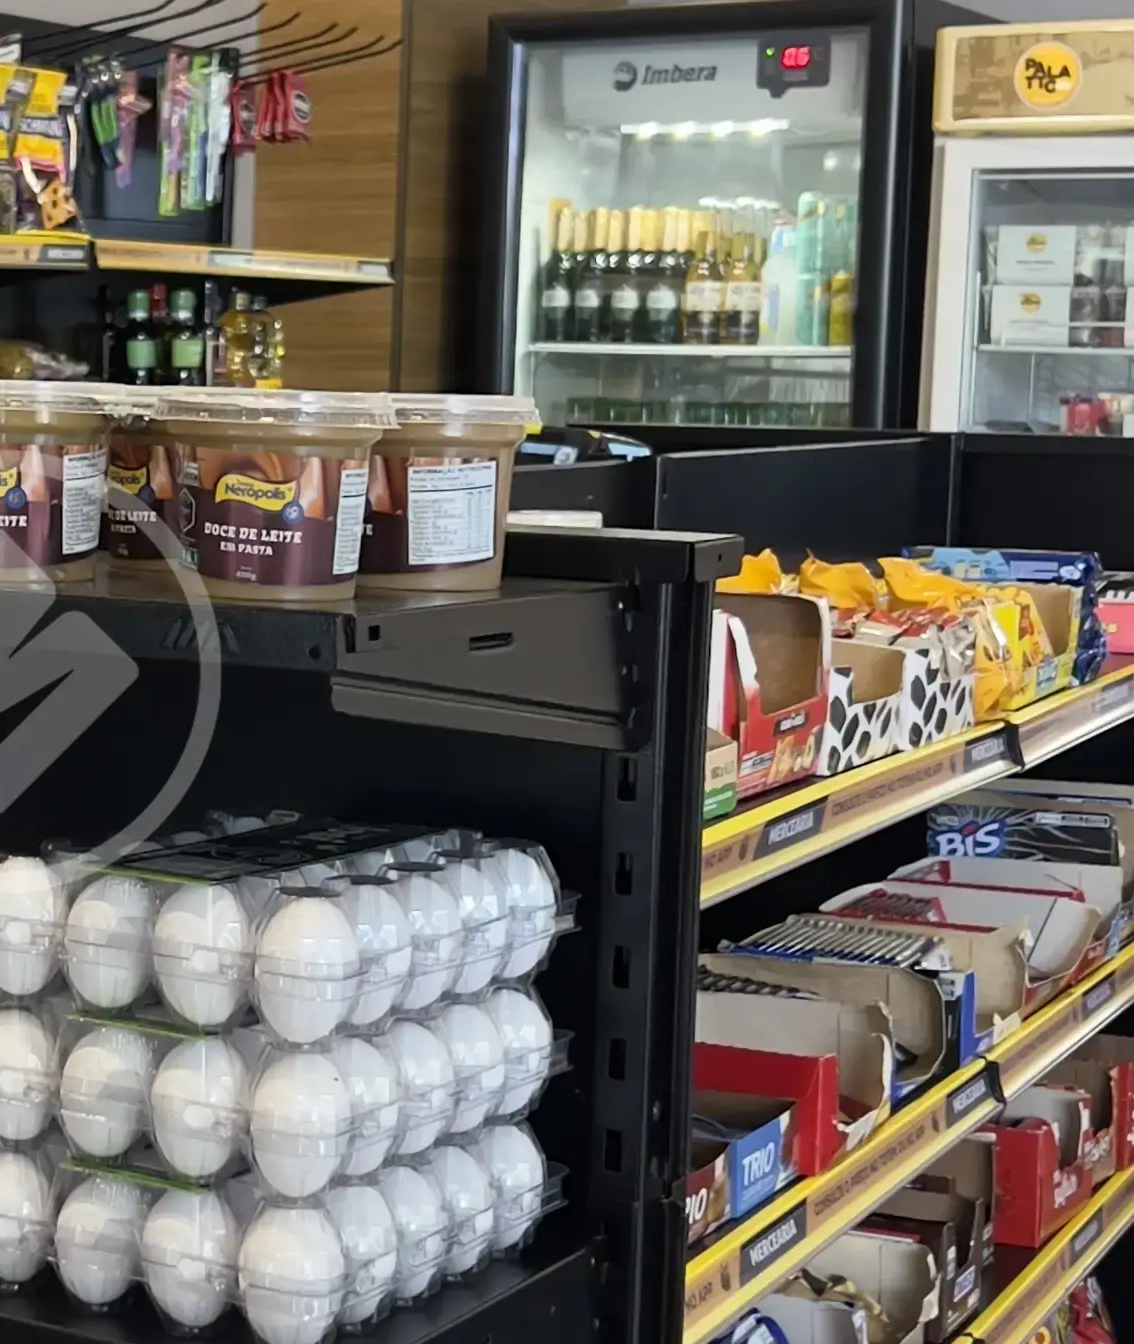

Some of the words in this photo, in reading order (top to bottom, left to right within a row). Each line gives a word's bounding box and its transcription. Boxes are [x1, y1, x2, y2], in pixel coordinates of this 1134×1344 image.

[641, 64, 718, 86] Imbera
[224, 482, 287, 502] Nerópolis
[203, 522, 237, 539] DOCE
[239, 526, 259, 541] DE
[260, 528, 303, 545] LEITE
[239, 542, 274, 556] PASTA
[741, 1141, 775, 1183] TRIO
[749, 1218, 798, 1267] MERCEARIA
